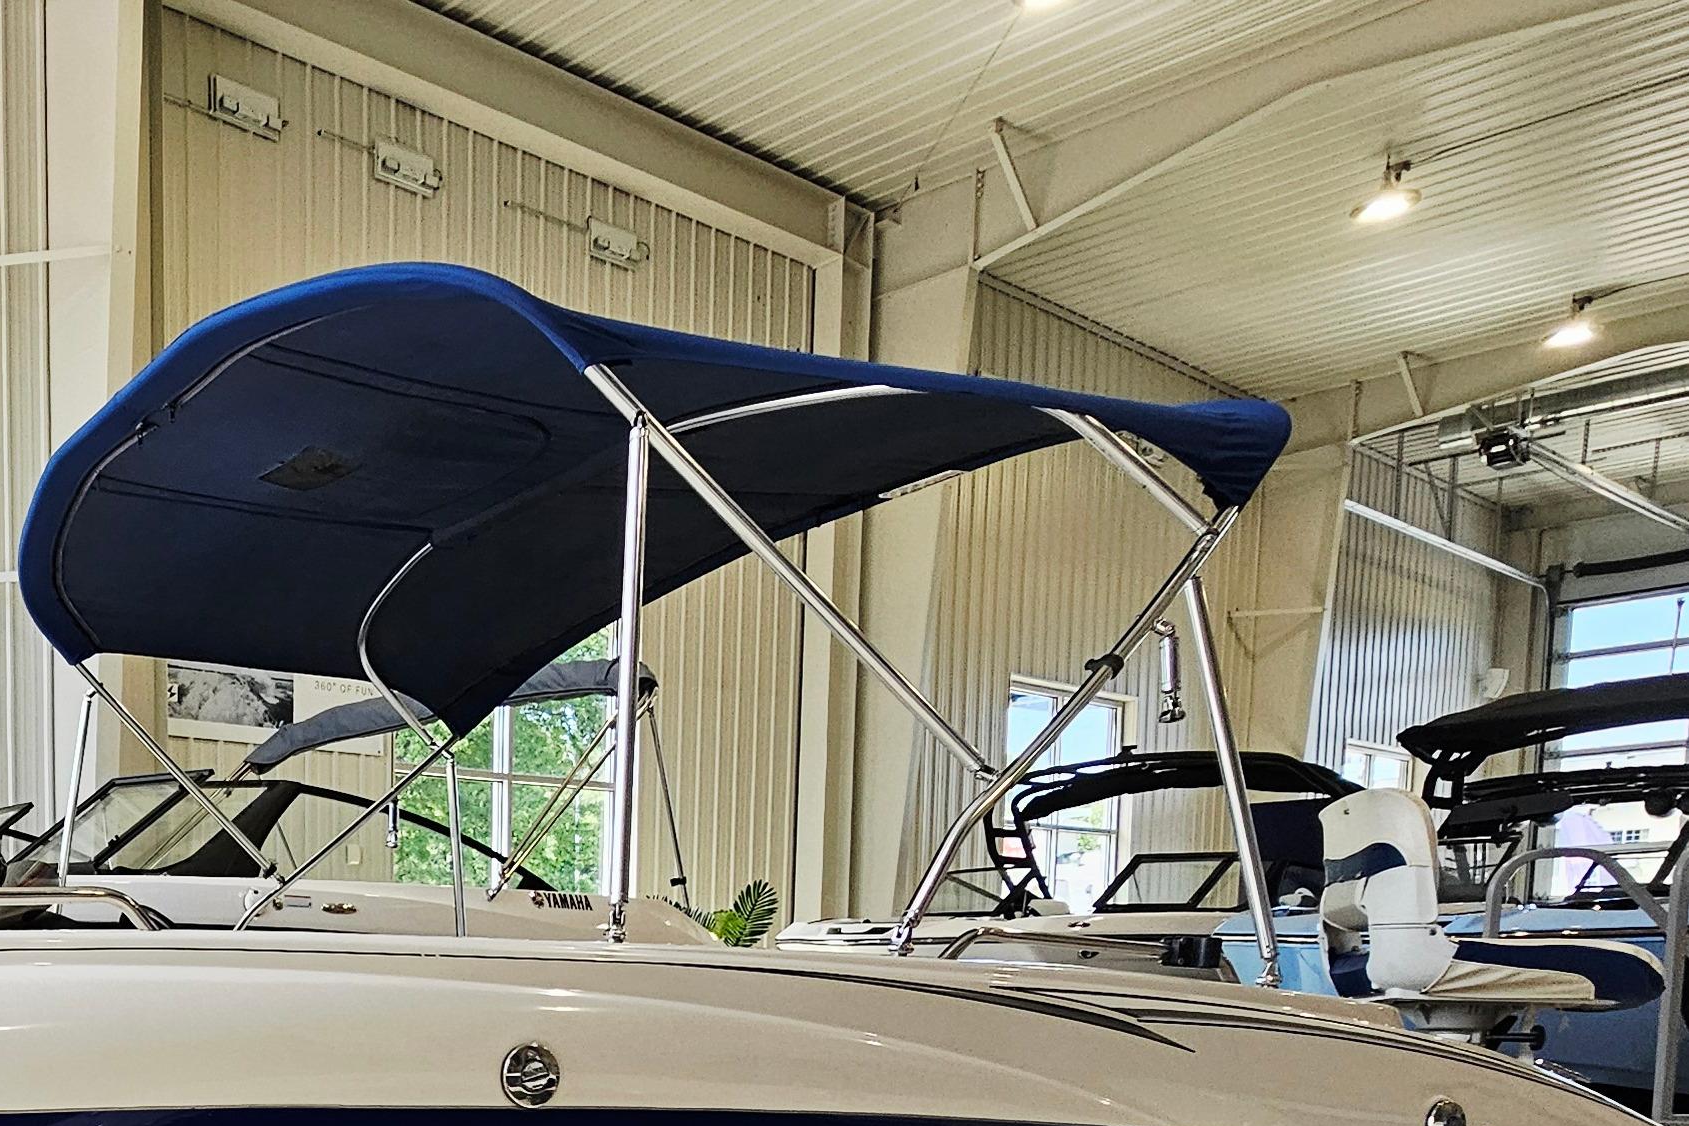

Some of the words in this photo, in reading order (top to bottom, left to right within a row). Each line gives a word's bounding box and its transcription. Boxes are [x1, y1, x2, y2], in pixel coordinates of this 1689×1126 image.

[339, 683, 352, 694] OF
[355, 685, 374, 697] FUN
[543, 891, 593, 911] YAMAHA
